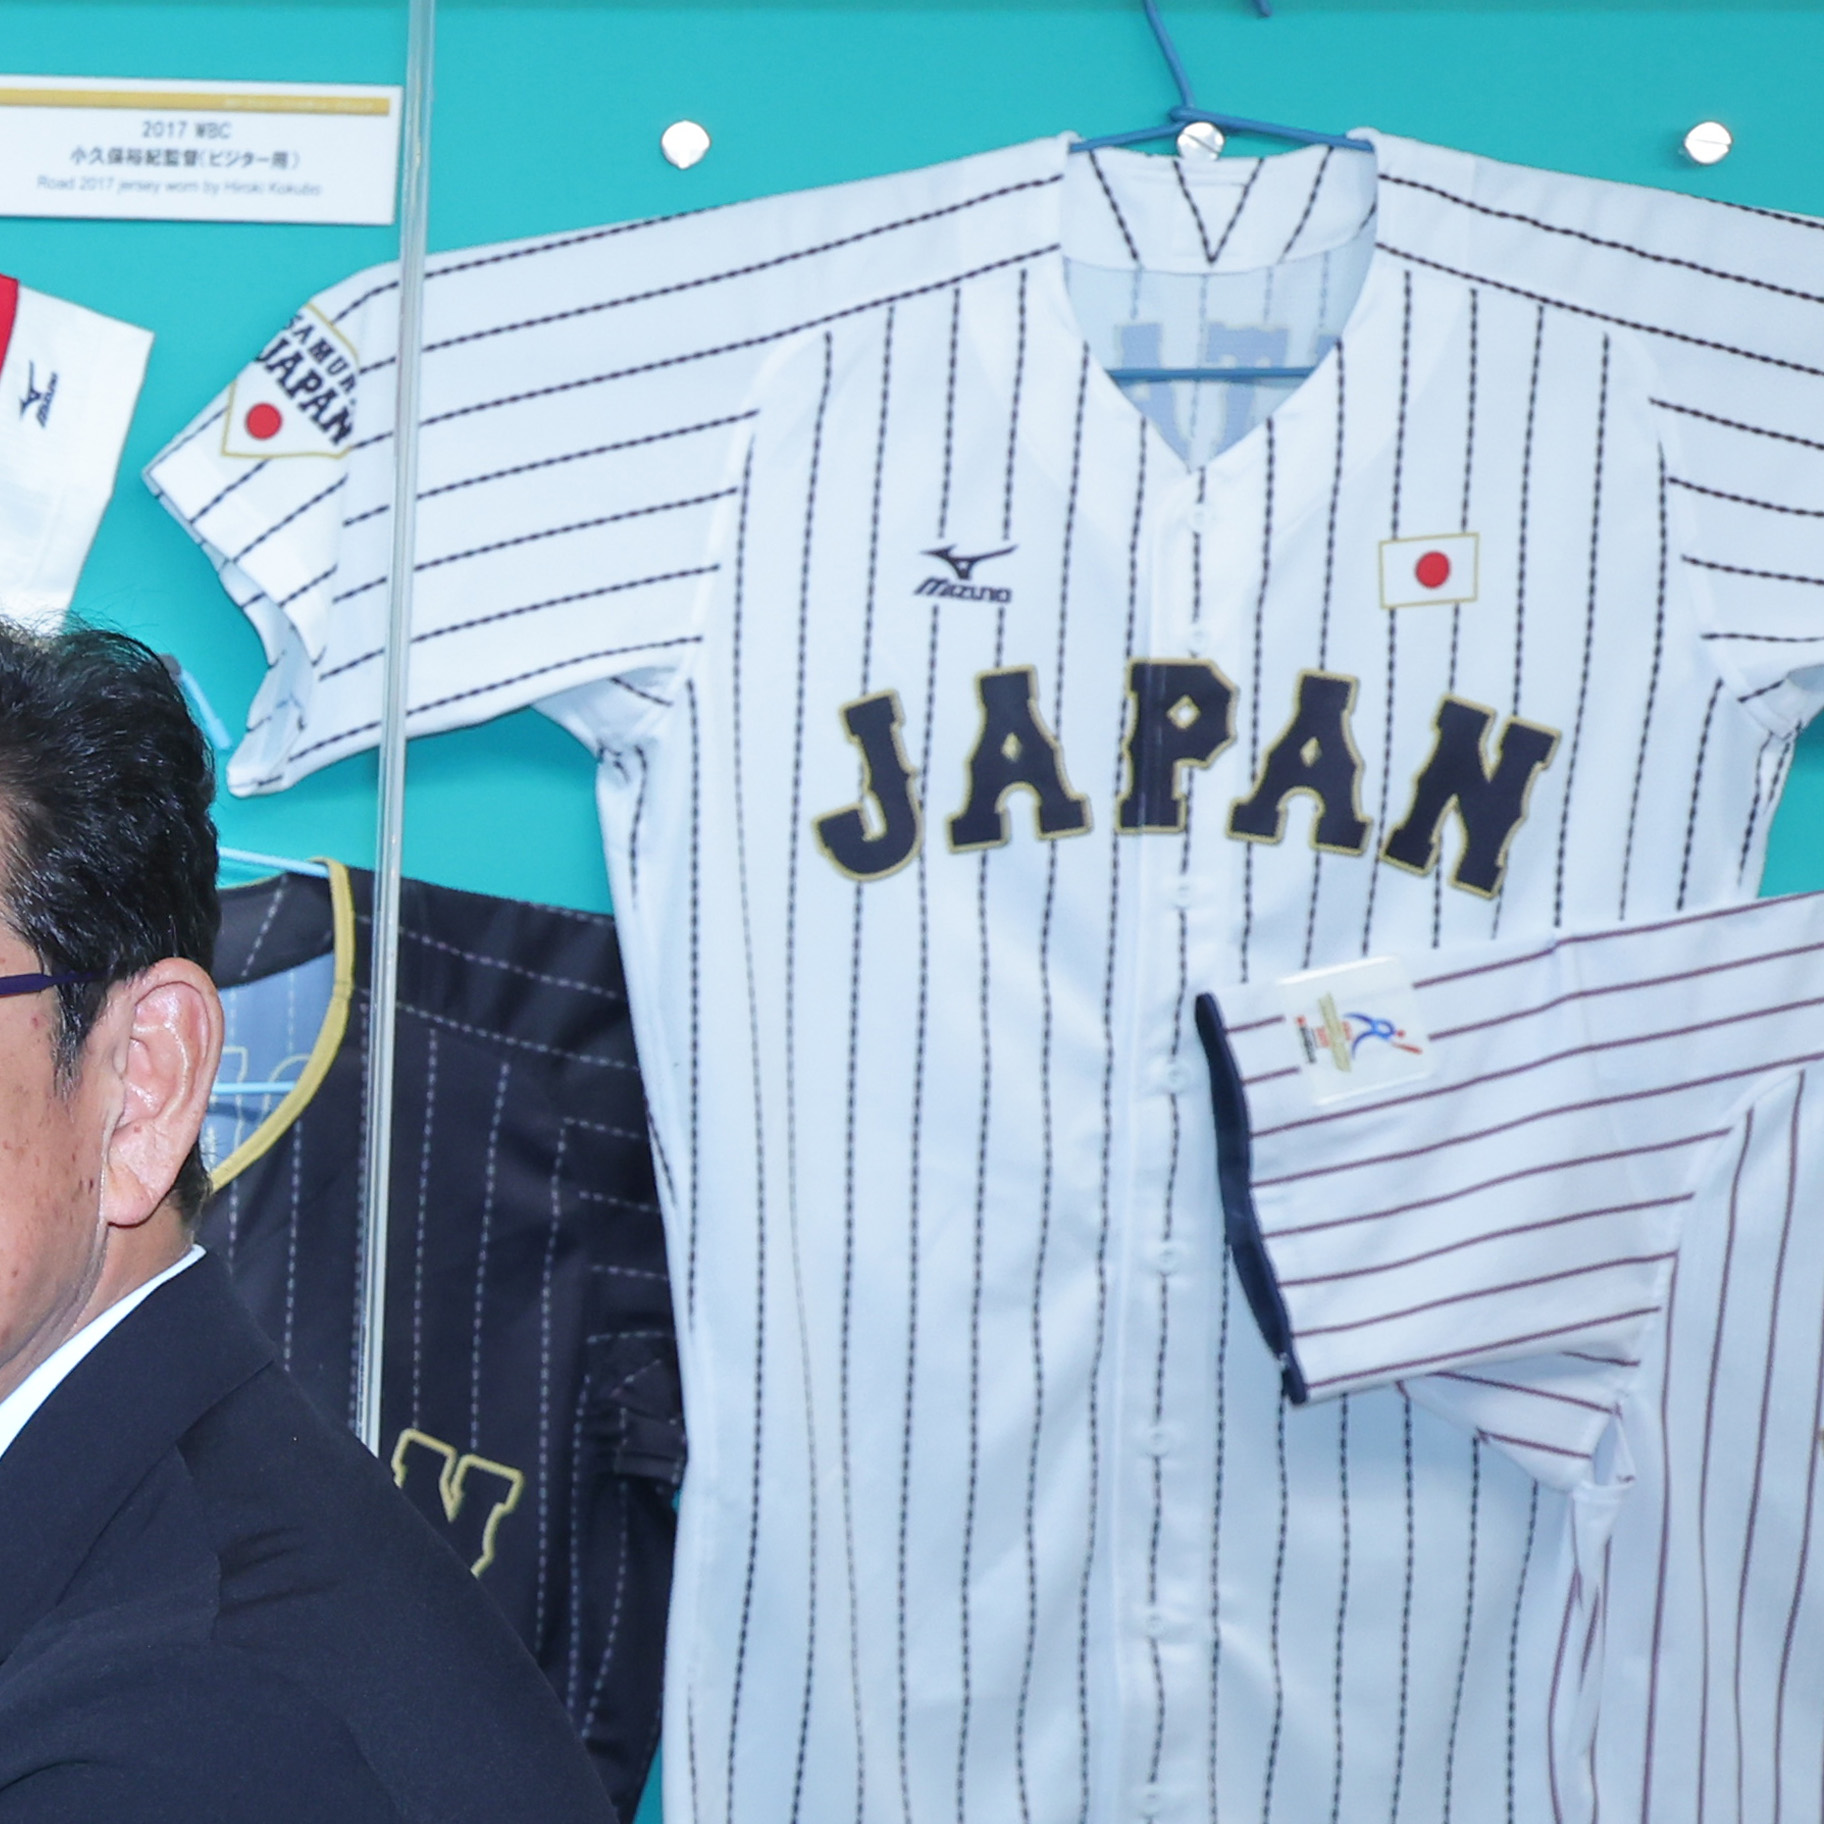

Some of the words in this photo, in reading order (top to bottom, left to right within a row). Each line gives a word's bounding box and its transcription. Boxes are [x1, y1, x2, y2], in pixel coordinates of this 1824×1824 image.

[142, 121, 188, 139] 2017
[195, 122, 232, 140] WBC
[37, 175, 75, 191] Road
[79, 176, 115, 191] 2017
[254, 337, 355, 446] JAPAN
[811, 656, 1563, 899] JAPAN
